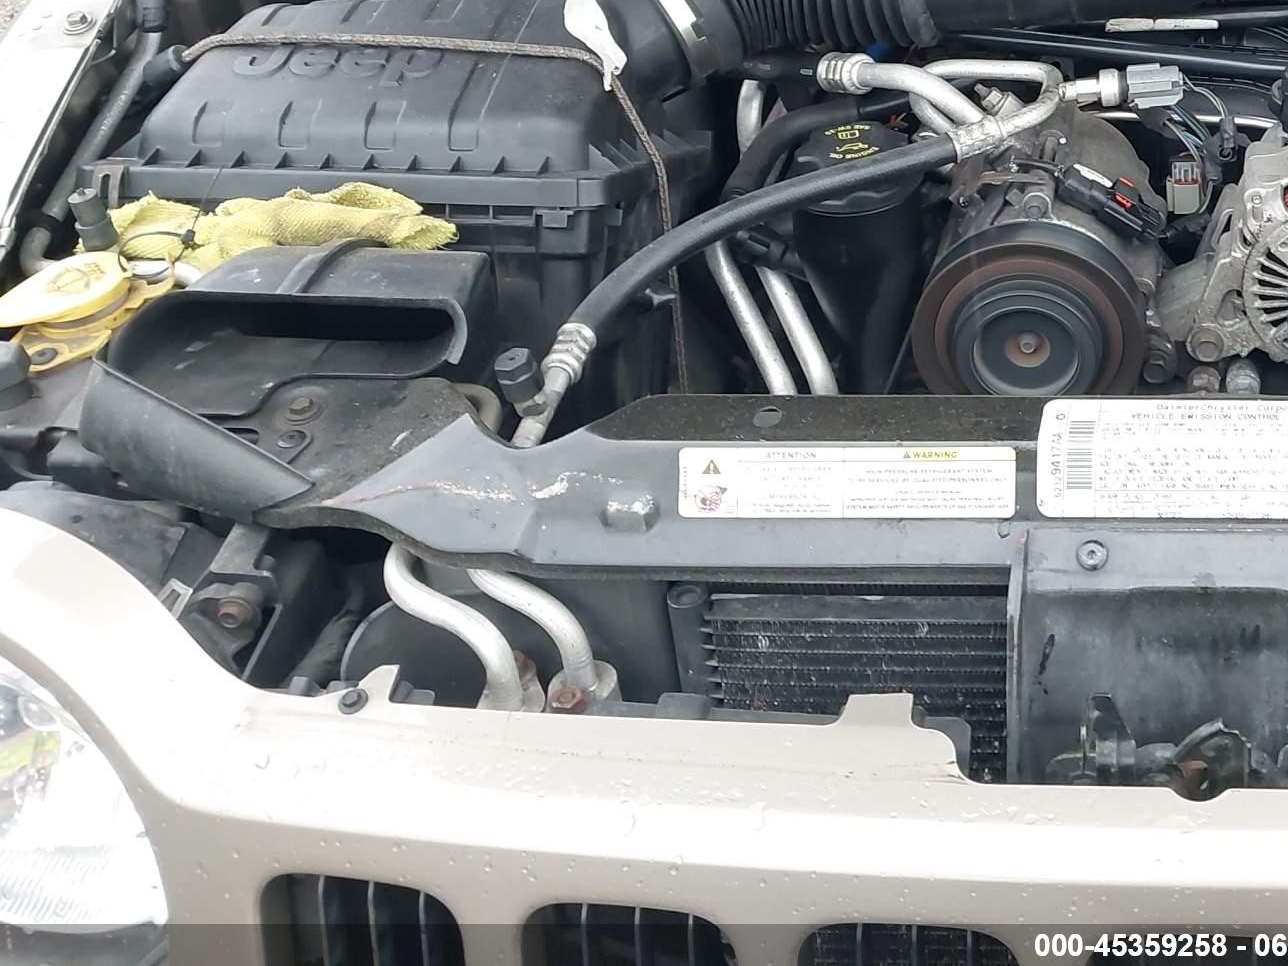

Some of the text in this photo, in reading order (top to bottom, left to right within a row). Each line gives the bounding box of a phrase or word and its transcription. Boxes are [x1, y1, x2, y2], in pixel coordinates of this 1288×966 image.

[232, 42, 445, 88] Jeep
[1131, 412, 1174, 421] VEHICLE
[1180, 413, 1232, 421] EMISSION
[1237, 413, 1280, 421] CONTROL
[766, 450, 958, 460] ATTENTION WARNING
